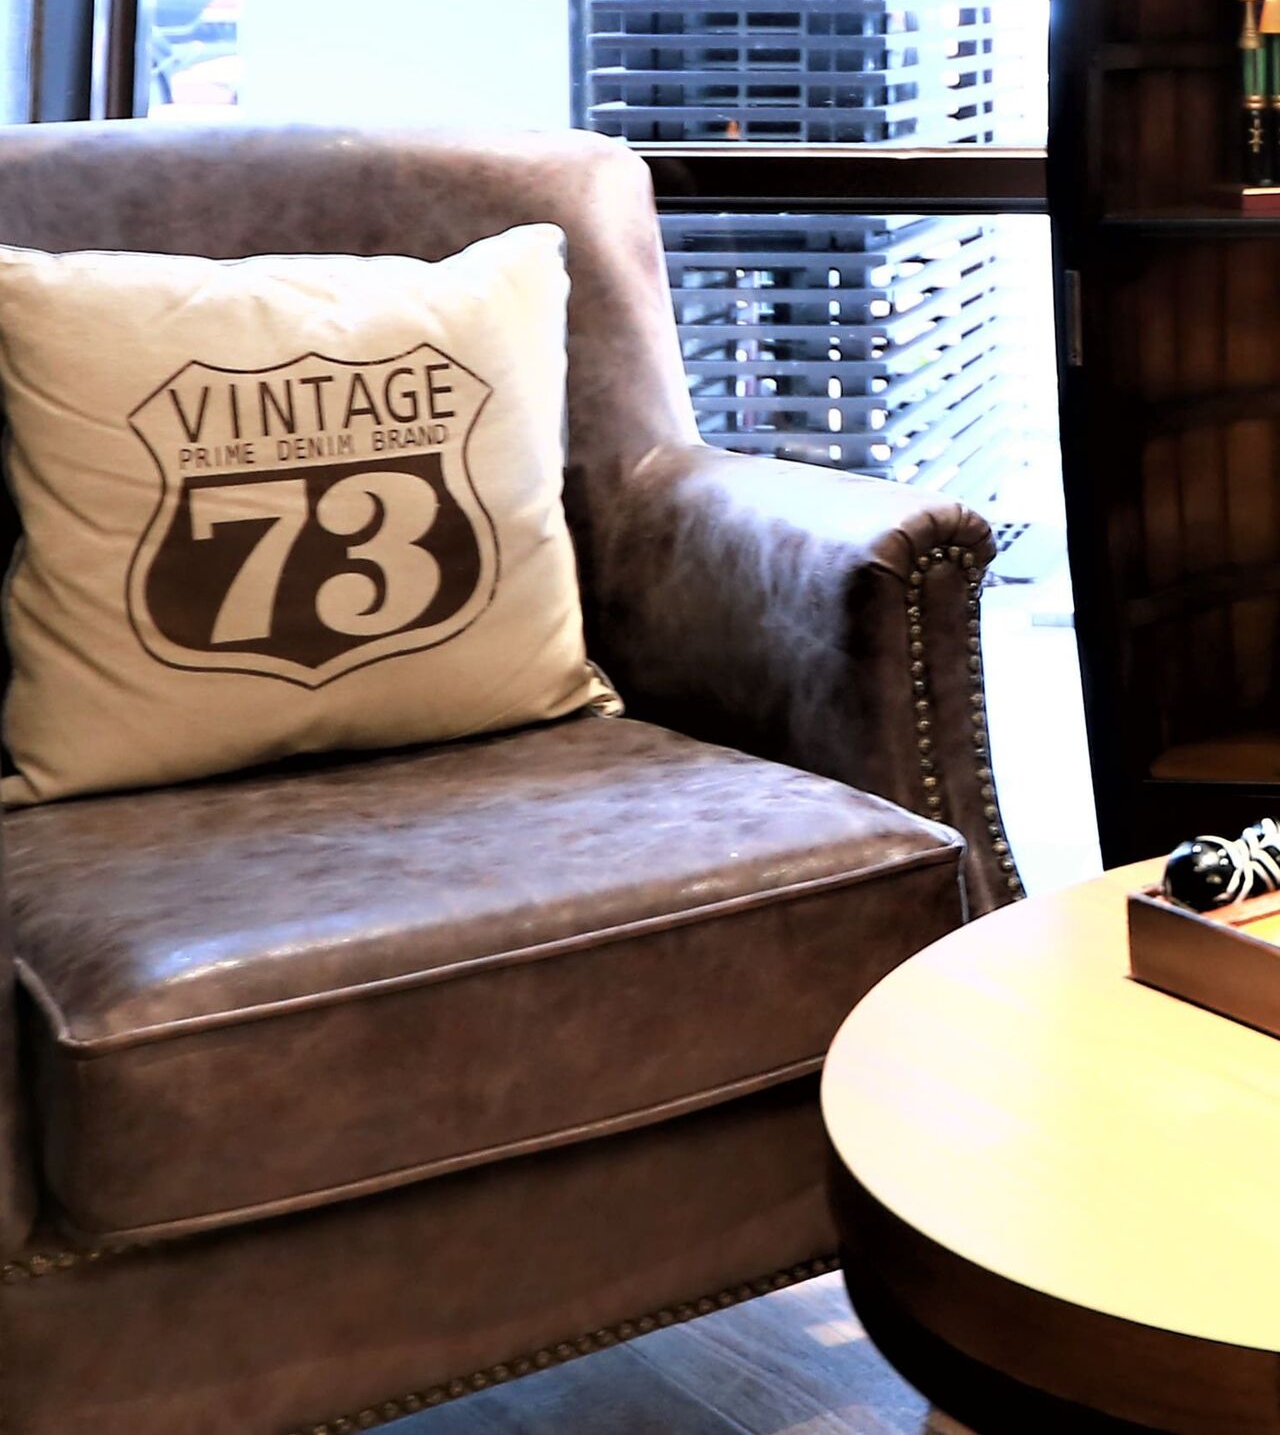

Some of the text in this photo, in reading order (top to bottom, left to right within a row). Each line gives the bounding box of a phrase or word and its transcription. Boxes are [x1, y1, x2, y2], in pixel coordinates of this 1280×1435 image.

[168, 363, 456, 443] VINTAGE
[178, 423, 450, 470] PRIME DENIM BRAND
[189, 470, 442, 645] 73
